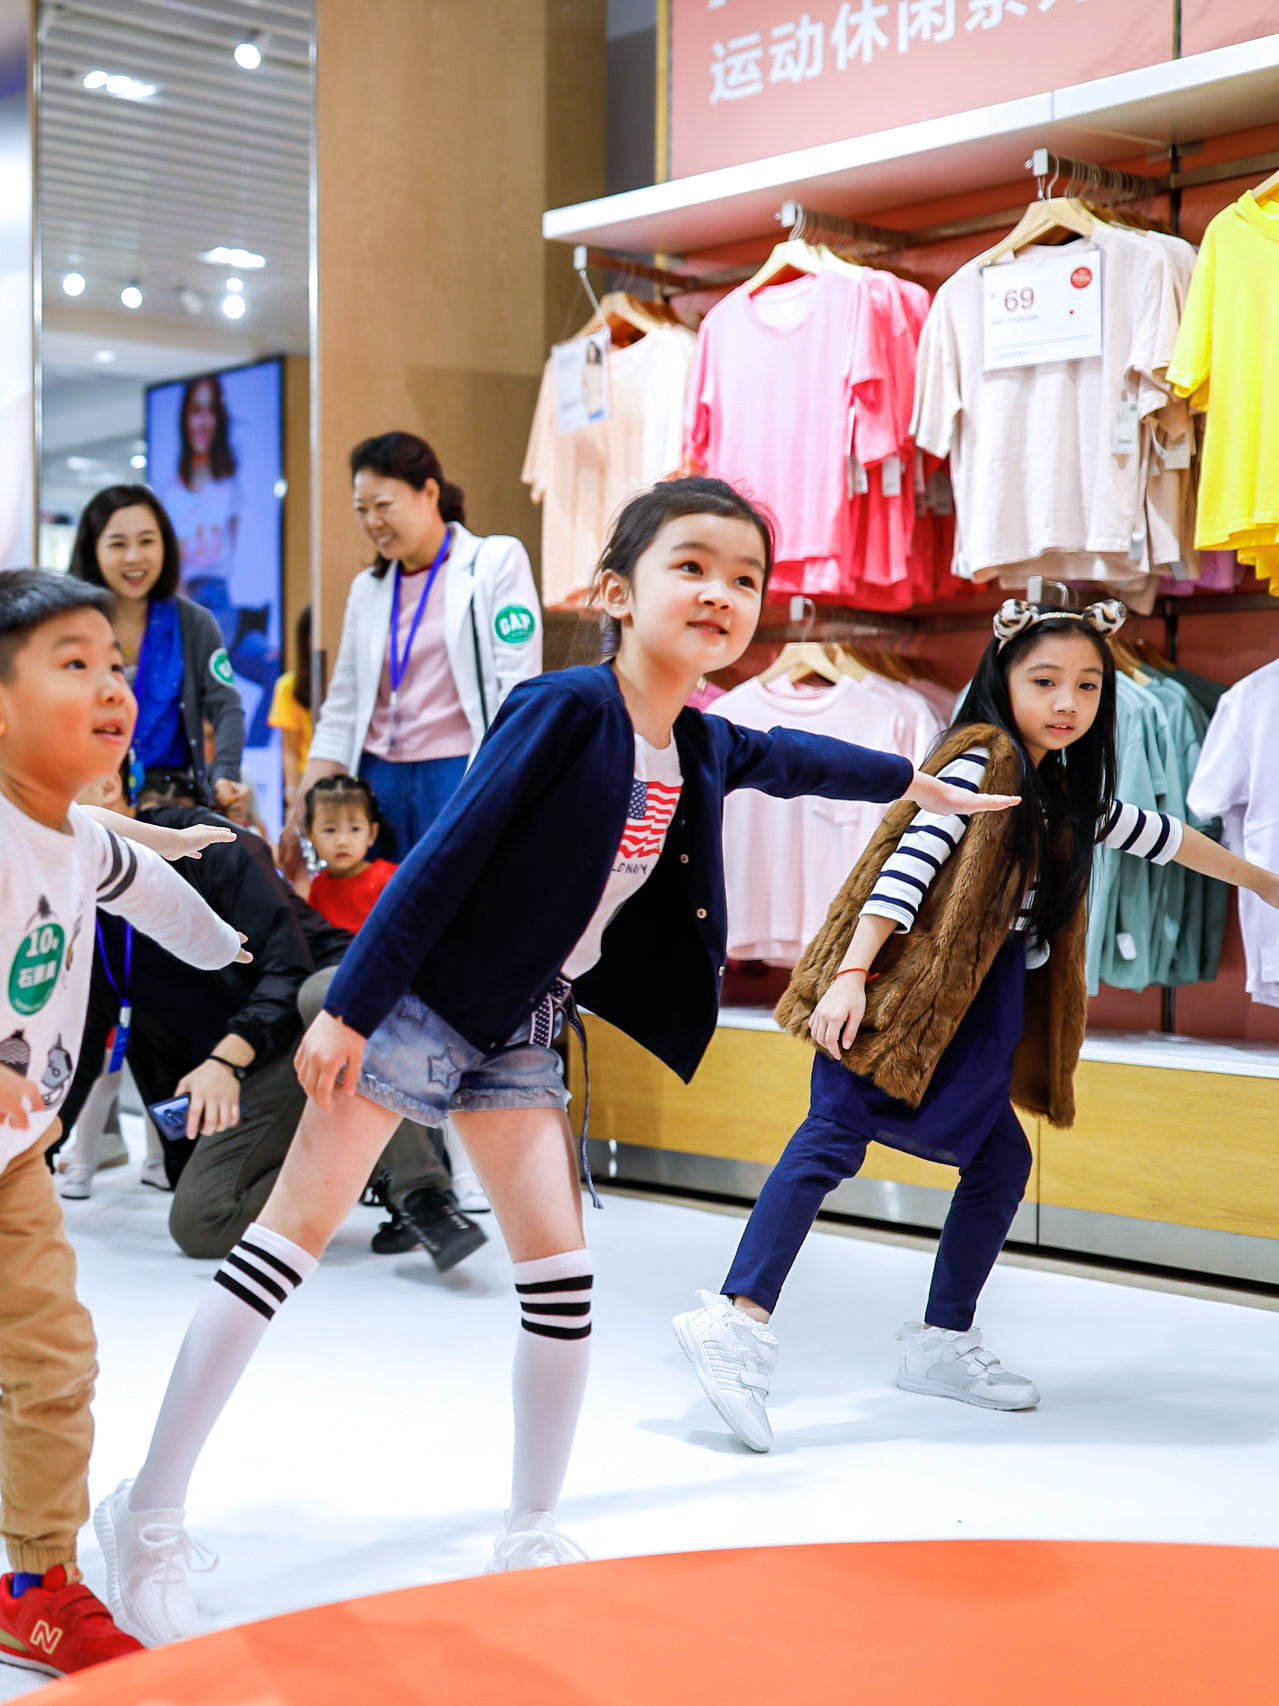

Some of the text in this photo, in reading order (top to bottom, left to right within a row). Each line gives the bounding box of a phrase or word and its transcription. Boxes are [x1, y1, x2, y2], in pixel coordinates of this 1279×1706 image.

[708, 0, 1086, 106] 运动休闲
[1004, 286, 1035, 312] 69
[30, 1619, 63, 1655] N
